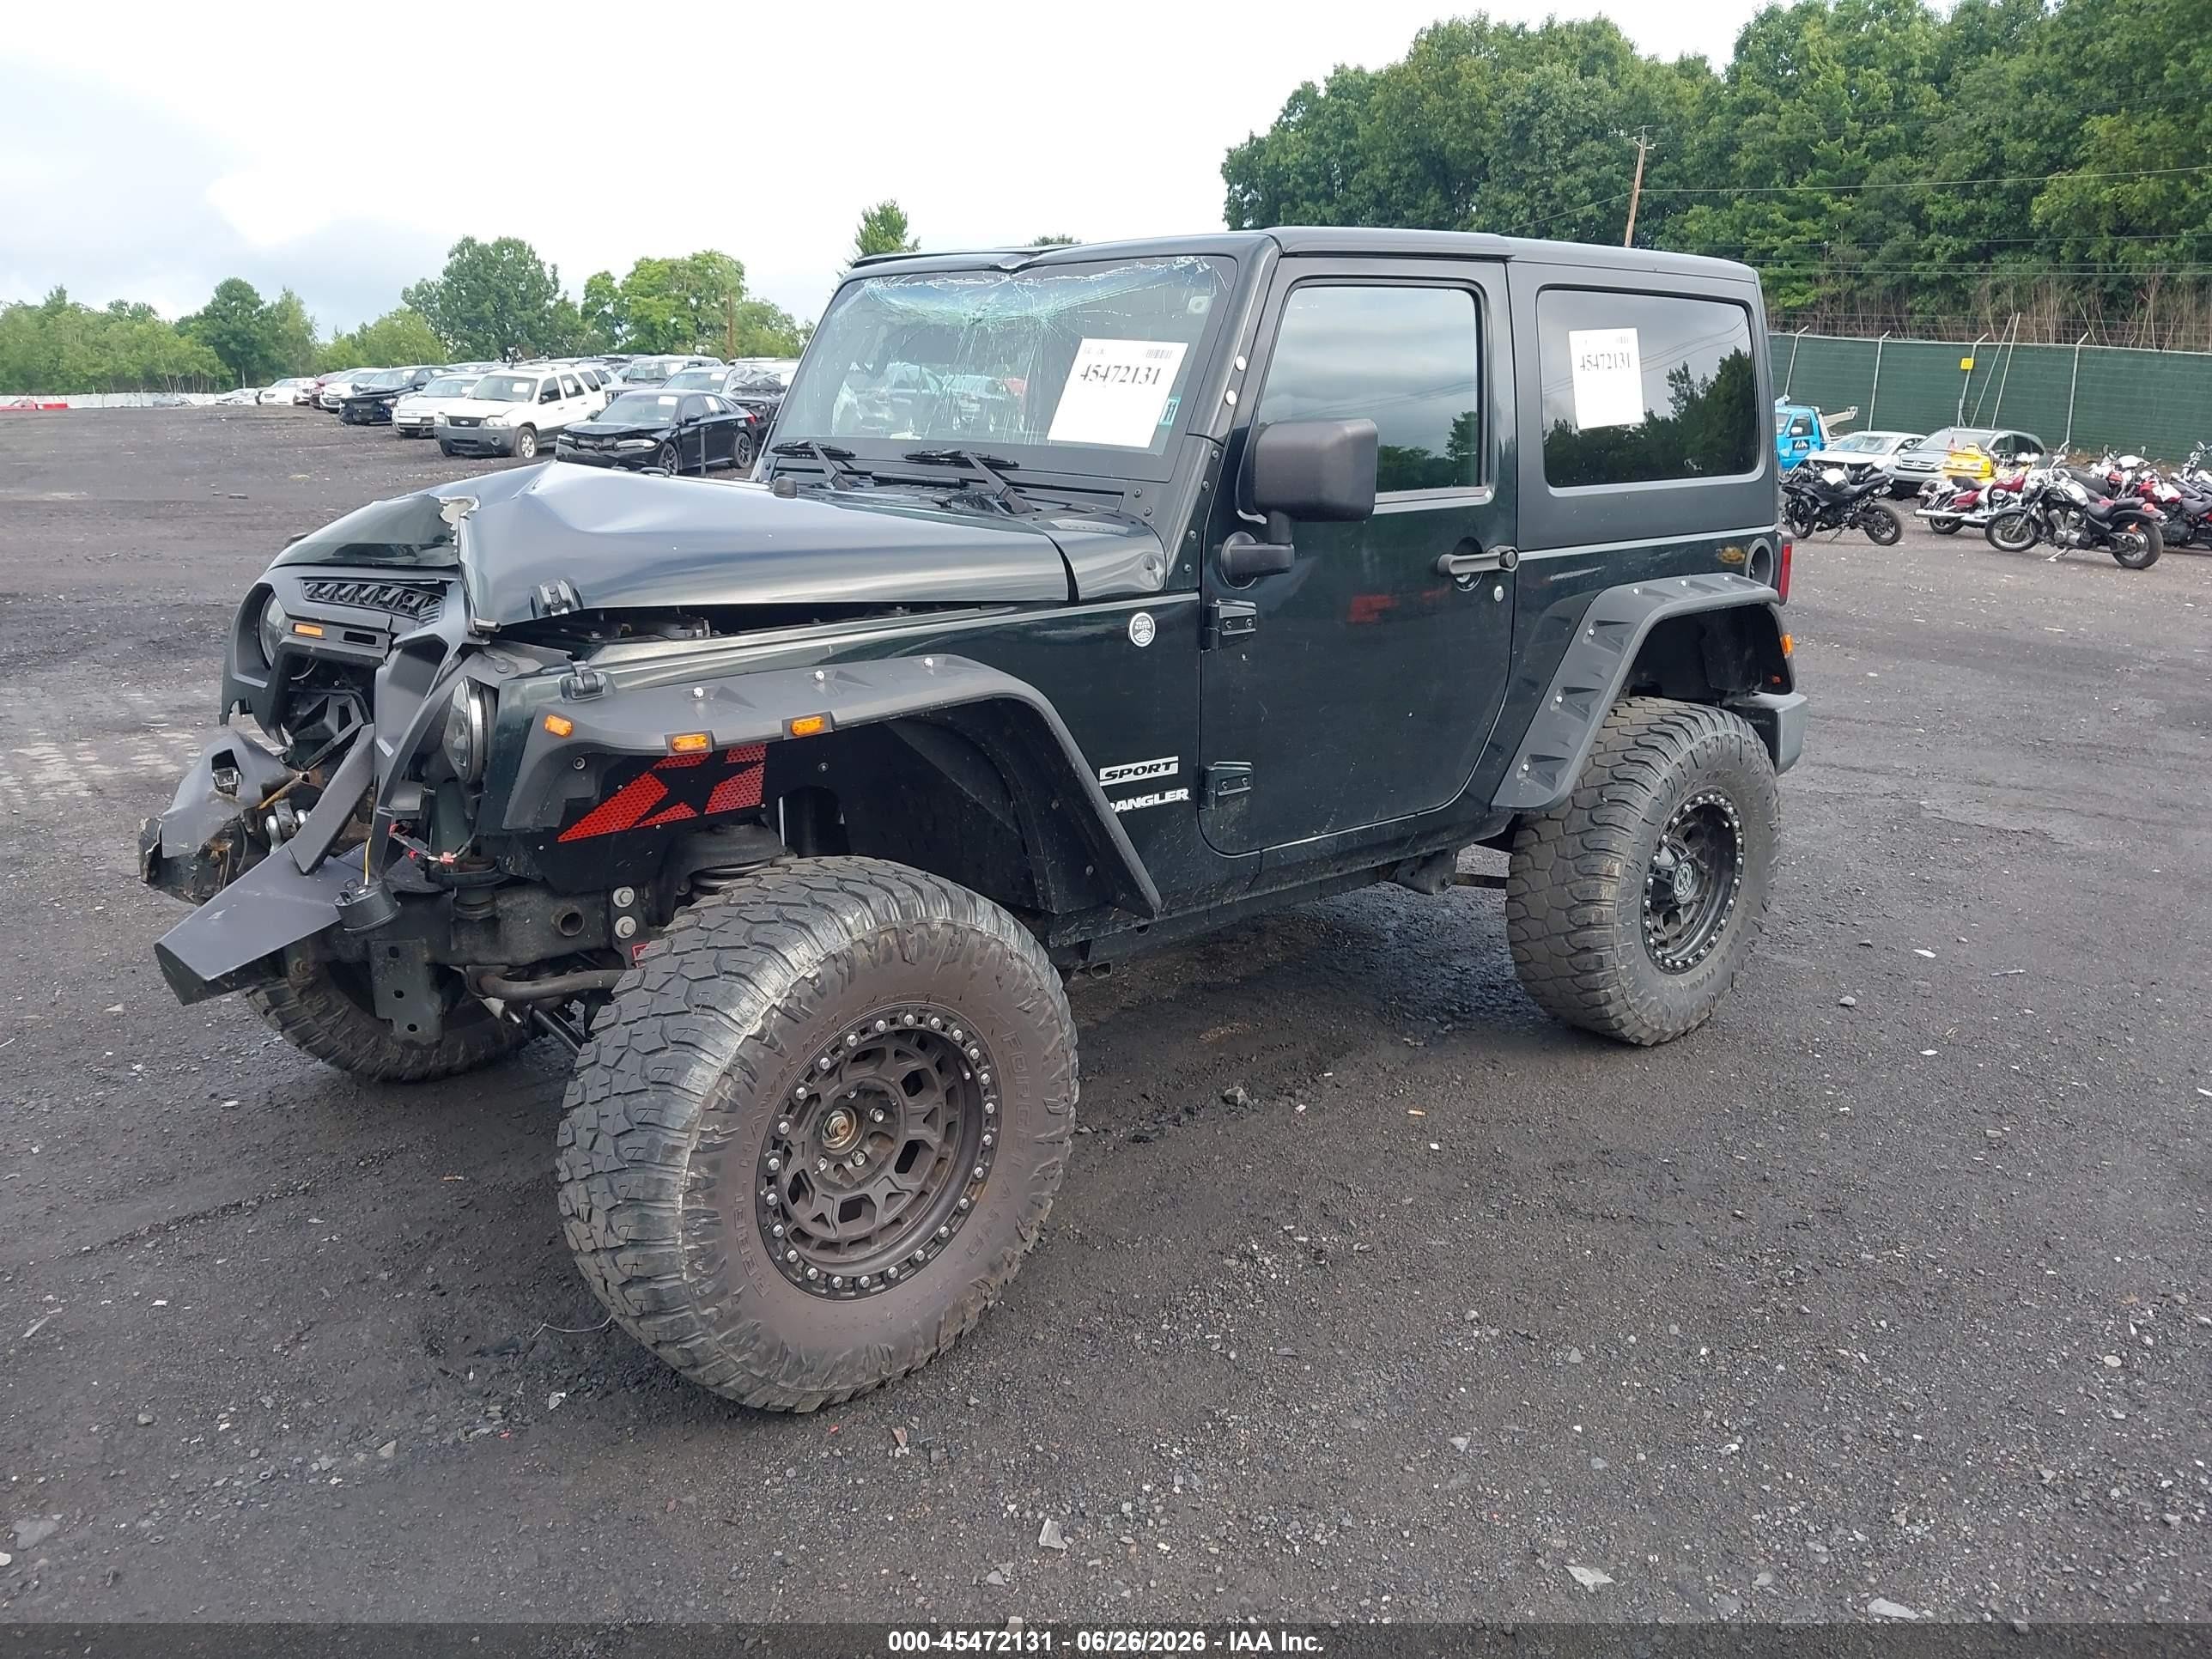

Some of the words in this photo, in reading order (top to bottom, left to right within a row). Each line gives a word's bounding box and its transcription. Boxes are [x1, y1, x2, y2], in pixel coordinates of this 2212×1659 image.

[1580, 351, 1631, 371] 45472131
[1080, 363, 1162, 386] 45472131
[1101, 761, 1177, 781] SPORT
[1109, 788, 1190, 812] ANGLER
